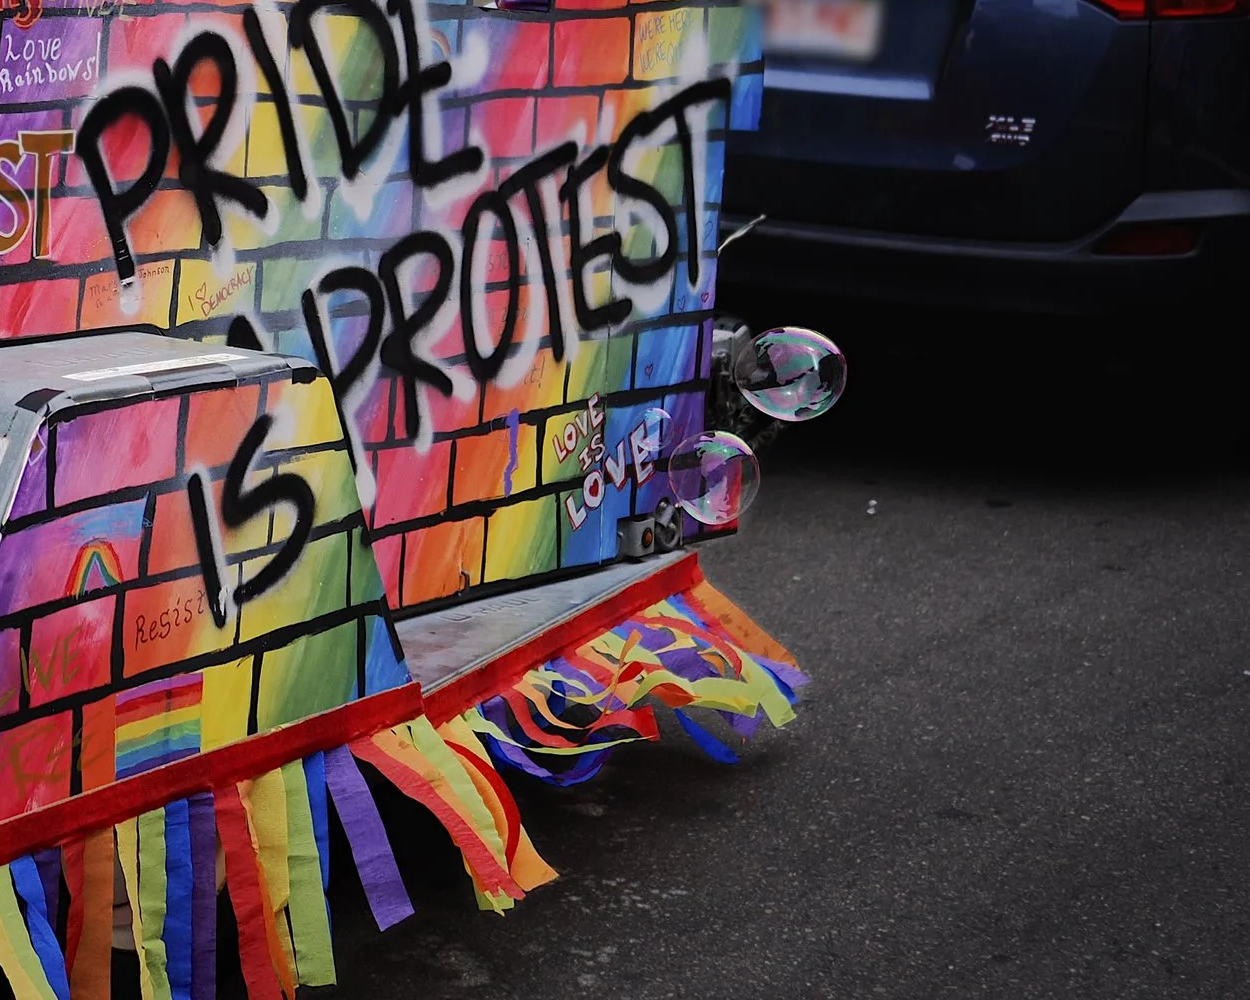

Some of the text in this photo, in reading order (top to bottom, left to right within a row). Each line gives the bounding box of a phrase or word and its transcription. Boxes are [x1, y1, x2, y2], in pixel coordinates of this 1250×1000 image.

[5, 34, 62, 63] Love
[138, 265, 170, 279] Johnson
[200, 265, 254, 318] DEMOCRACY
[302, 79, 731, 476] PROTEST
[553, 392, 604, 464] LOVE
[578, 433, 605, 472] IS
[565, 420, 657, 532] LOVE
[187, 414, 315, 629] IS
